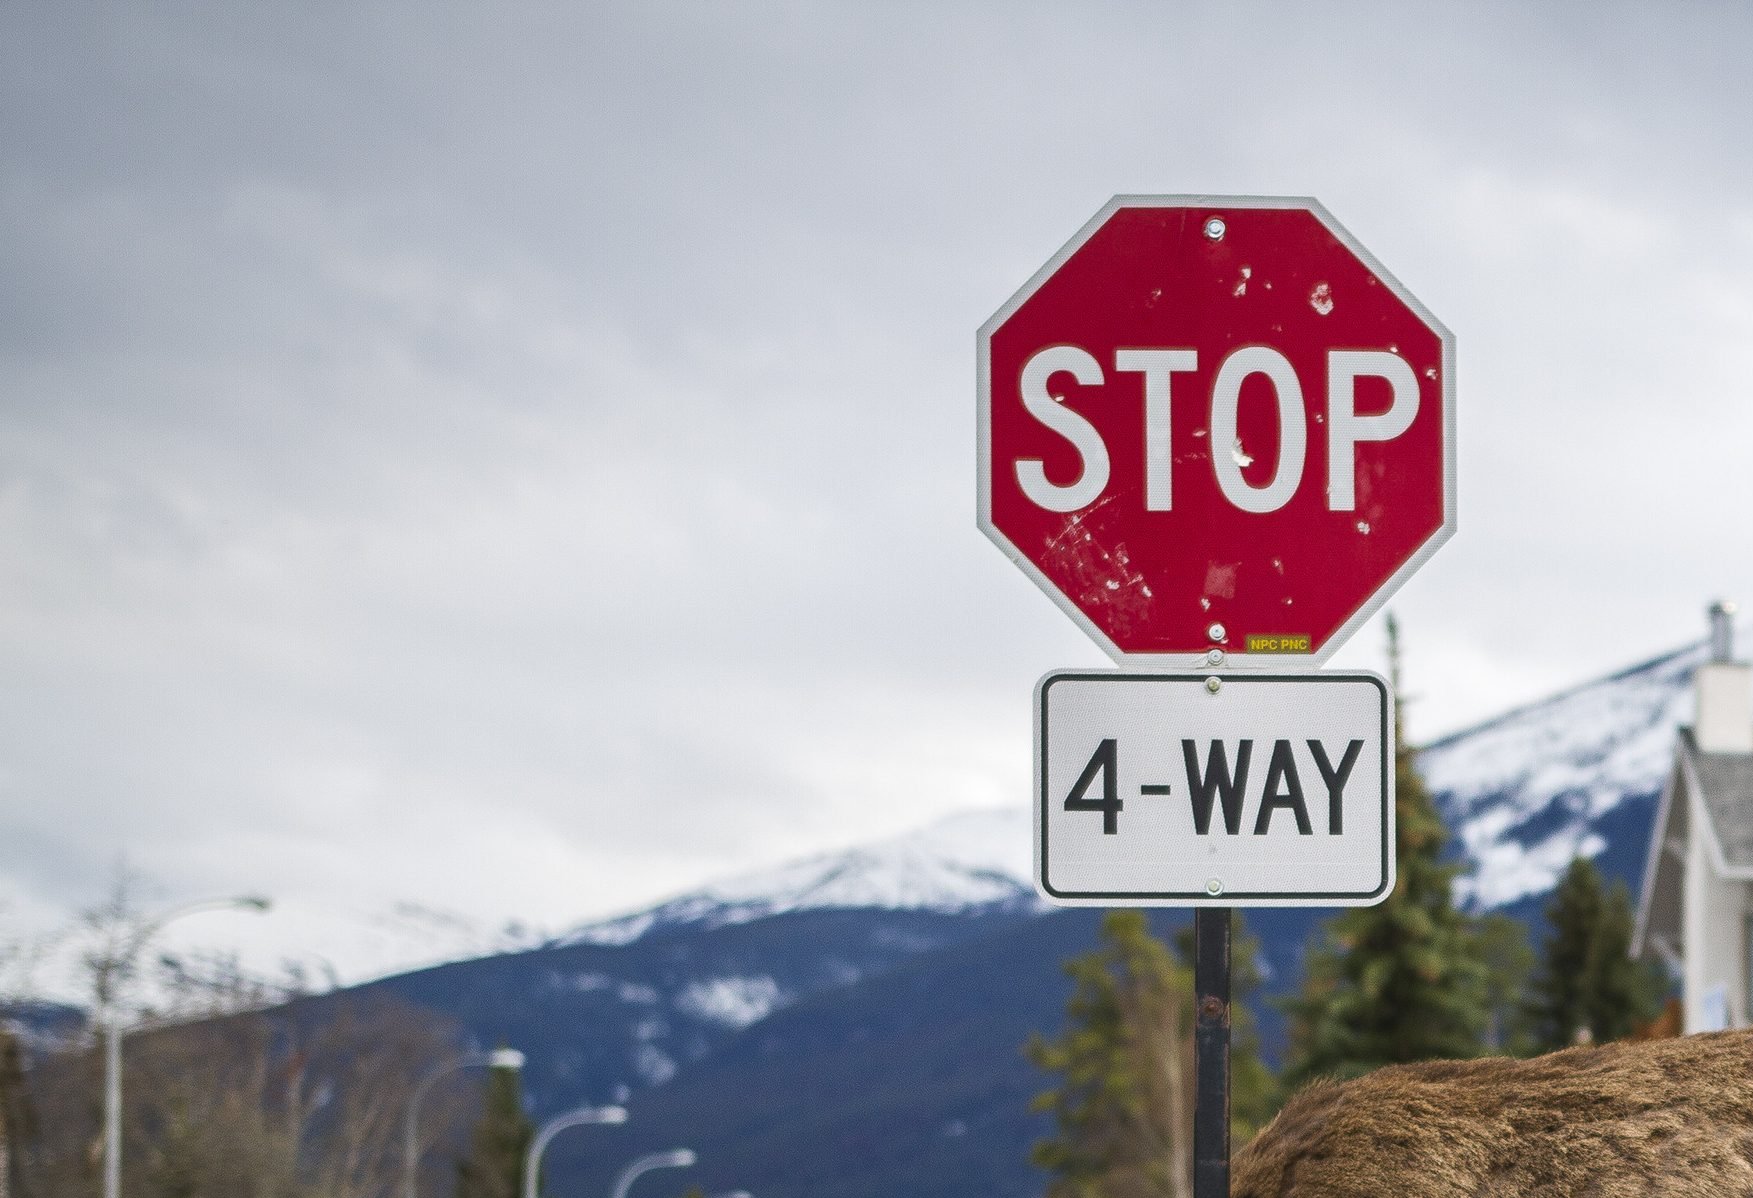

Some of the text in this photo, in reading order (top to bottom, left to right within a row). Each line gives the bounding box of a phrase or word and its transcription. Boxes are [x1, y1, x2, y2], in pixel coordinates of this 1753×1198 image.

[1015, 346, 1420, 512] STOP
[1250, 639, 1278, 651] NPC
[1064, 739, 1365, 835] 4-WAY
